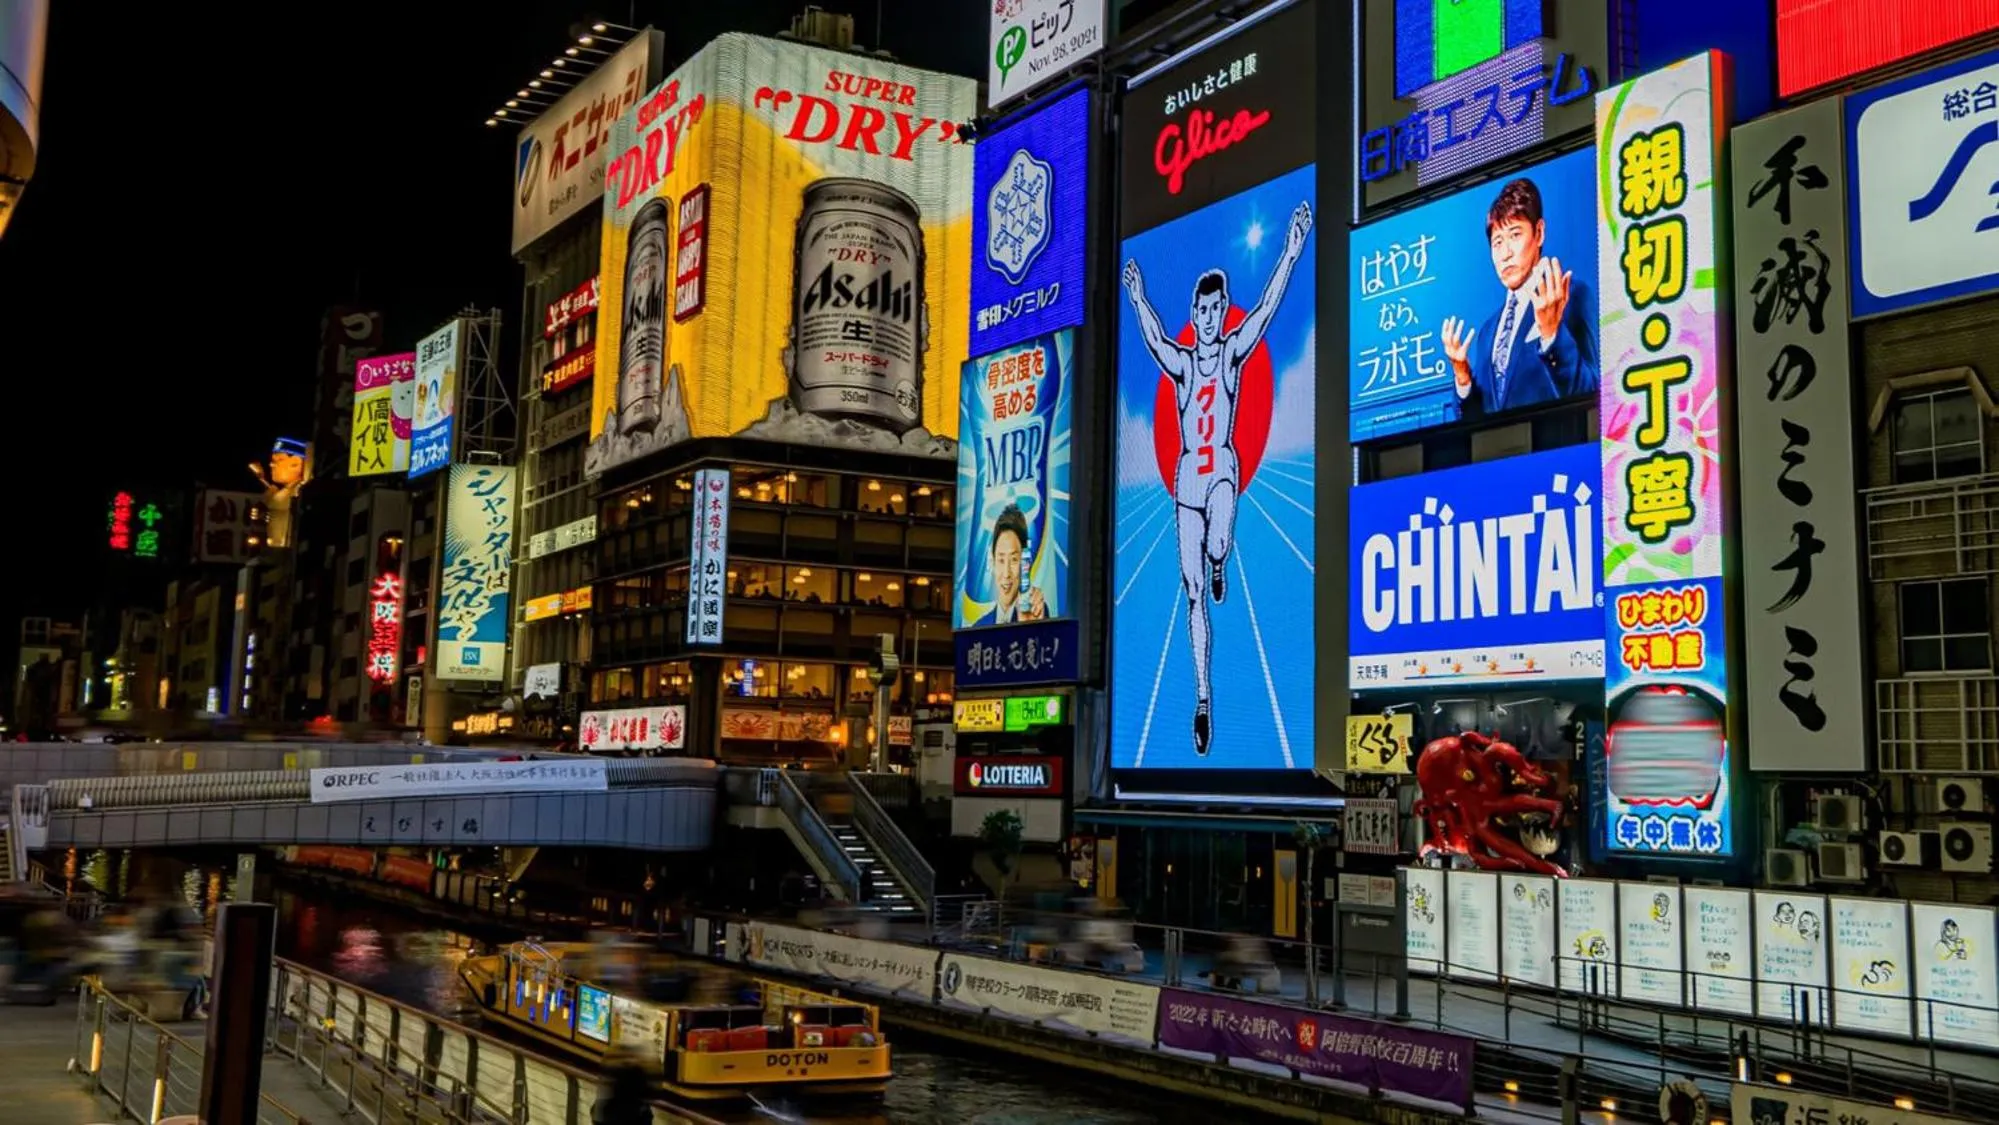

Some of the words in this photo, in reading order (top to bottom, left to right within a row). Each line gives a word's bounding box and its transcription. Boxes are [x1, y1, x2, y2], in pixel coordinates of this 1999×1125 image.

[1031, 0, 1075, 48] ピップ
[1028, 54, 1052, 75] Nov.
[1069, 24, 1098, 52] 2021
[824, 69, 917, 108] SUPER
[1164, 52, 1259, 116] おいしさと健康
[1942, 80, 1999, 125] 総合
[1361, 50, 1597, 184] 日商エステム
[1154, 108, 1271, 195] Glico
[1360, 233, 1437, 294] はやす
[802, 261, 912, 325] Asahi
[975, 282, 1060, 332] 雪印メグミルク
[840, 319, 874, 343] 生
[1619, 123, 1696, 545] 親切・丁寧
[823, 351, 890, 369] スーパードライ
[987, 348, 1045, 391] 骨密度を
[1357, 333, 1447, 393] ラボモ。
[839, 390, 870, 404] 350ml
[993, 384, 1038, 422] 高める
[356, 401, 375, 473] バイト
[1196, 377, 1217, 475] グリコ
[1746, 135, 1834, 733] 不滅のミナミ
[985, 424, 1043, 488] MBP
[1361, 473, 1594, 634] CHINTAI
[703, 557, 721, 638] かに道楽
[1617, 586, 1705, 630] ひまわり
[1622, 630, 1704, 671] 不動産
[1358, 722, 1399, 765] くくる
[1575, 721, 1586, 762] 2F
[983, 764, 1045, 786] LOTTERIA
[363, 815, 481, 835] えびす橋
[1617, 815, 1722, 850] 年中無休
[1169, 1003, 1205, 1026] 2022年
[1211, 1008, 1293, 1042] 新たな時代へ
[1299, 1022, 1314, 1047] 祝
[766, 1052, 829, 1068] DOTON
